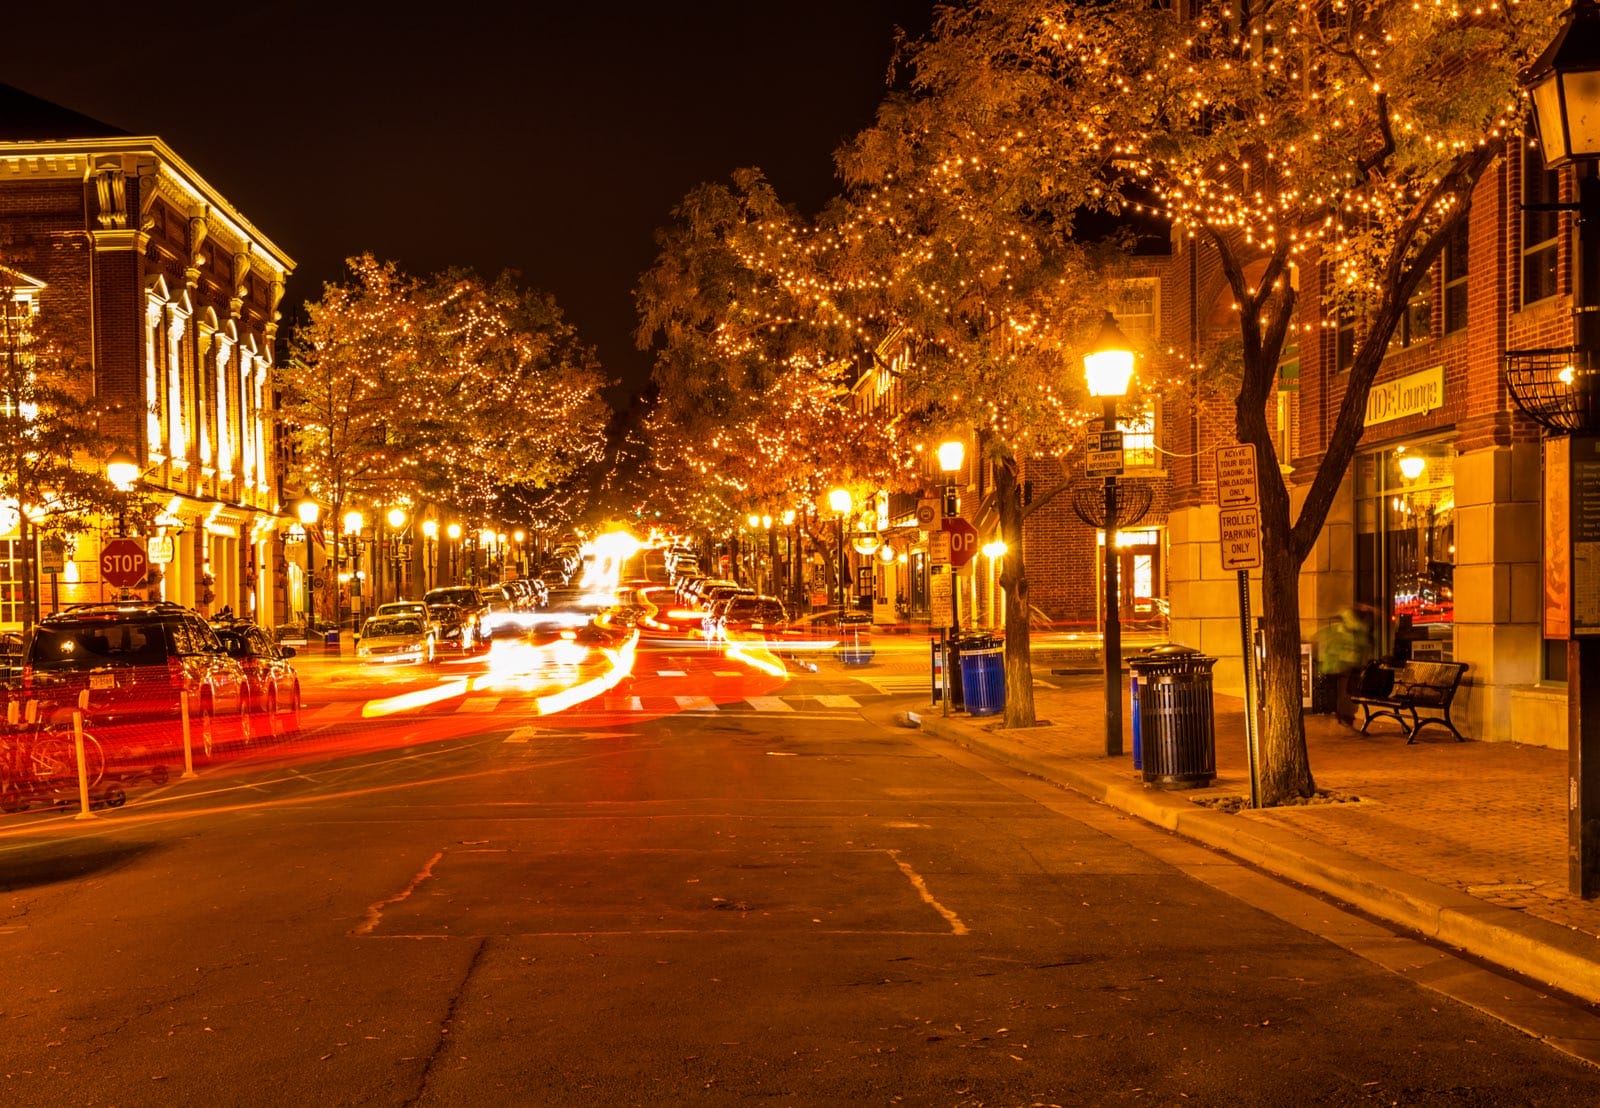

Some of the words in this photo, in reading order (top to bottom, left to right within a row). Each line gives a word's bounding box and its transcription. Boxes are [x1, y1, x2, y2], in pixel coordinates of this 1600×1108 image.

[1397, 381, 1437, 416] Lounge
[1224, 449, 1246, 458] ACTIVE
[1089, 461, 1120, 469] INFORMATION
[1220, 459, 1237, 468] TOUR
[1238, 458, 1252, 466] BUS
[1219, 468, 1245, 478] LOADING
[1219, 477, 1254, 488] UNLOADING
[1229, 487, 1245, 497] ONLY
[1222, 514, 1256, 527] TROLLEY
[1223, 527, 1257, 541] PARKING
[951, 533, 975, 551] OP
[1231, 542, 1250, 554] ONLY
[103, 554, 144, 573] STOP
